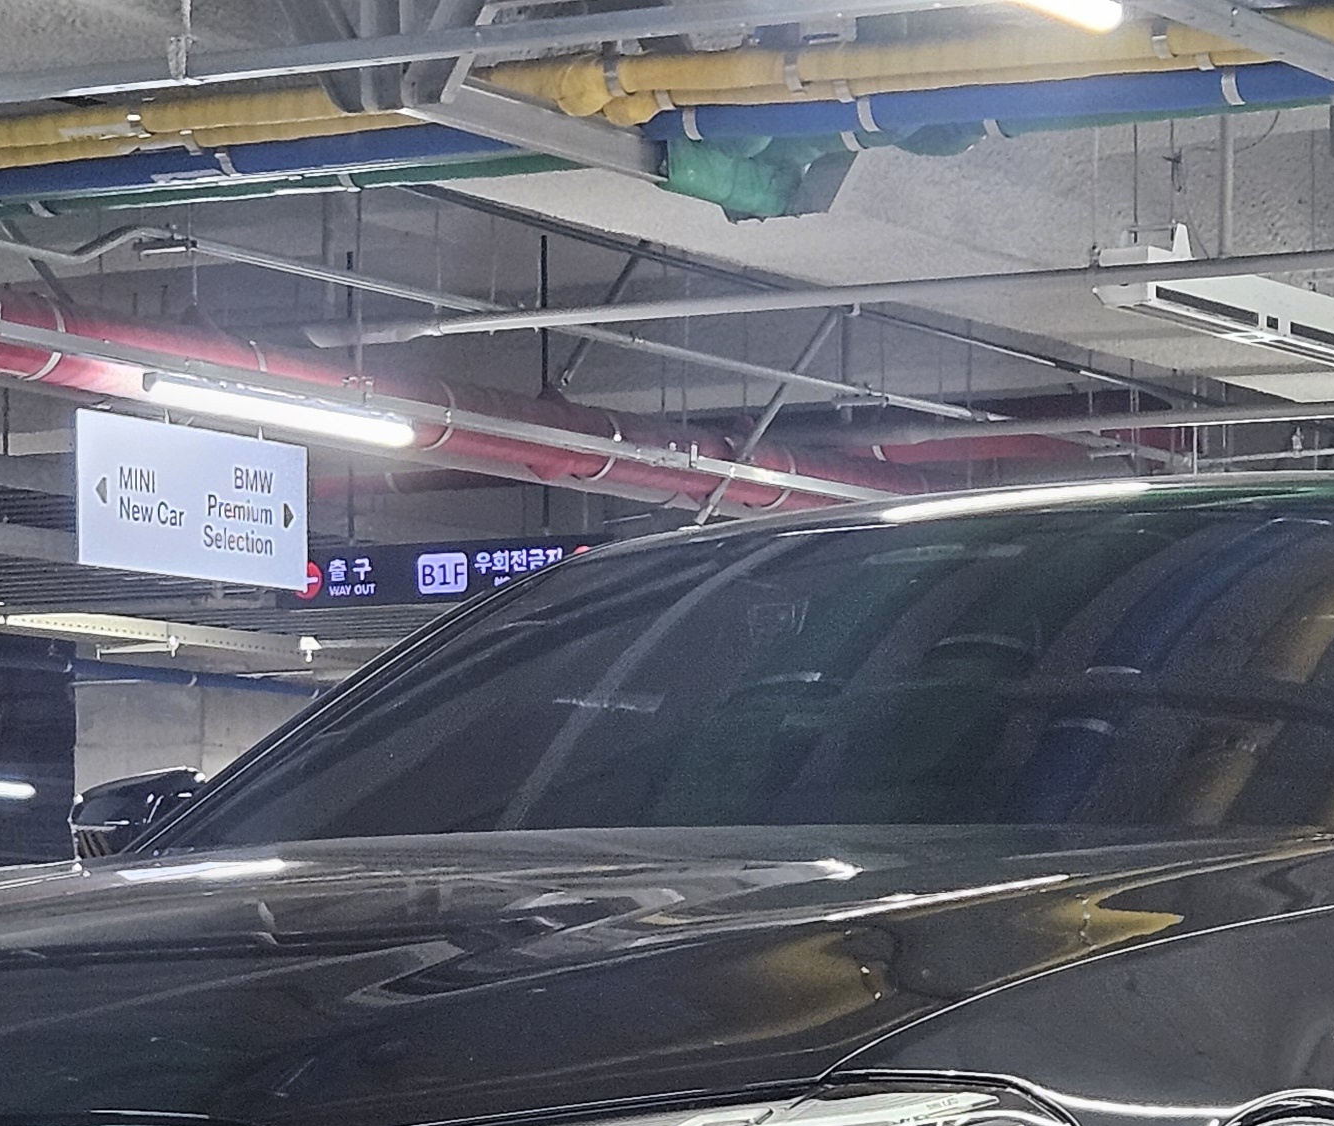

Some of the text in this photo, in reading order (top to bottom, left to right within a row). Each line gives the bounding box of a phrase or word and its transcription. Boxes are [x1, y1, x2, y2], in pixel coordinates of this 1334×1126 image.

[118, 465, 156, 494] MINI
[233, 466, 274, 495] BMW
[118, 495, 185, 528] New Car
[207, 493, 274, 526] Premium
[202, 524, 274, 556] Selection
[421, 562, 466, 587] B1F
[327, 582, 377, 597] WAY OUT
